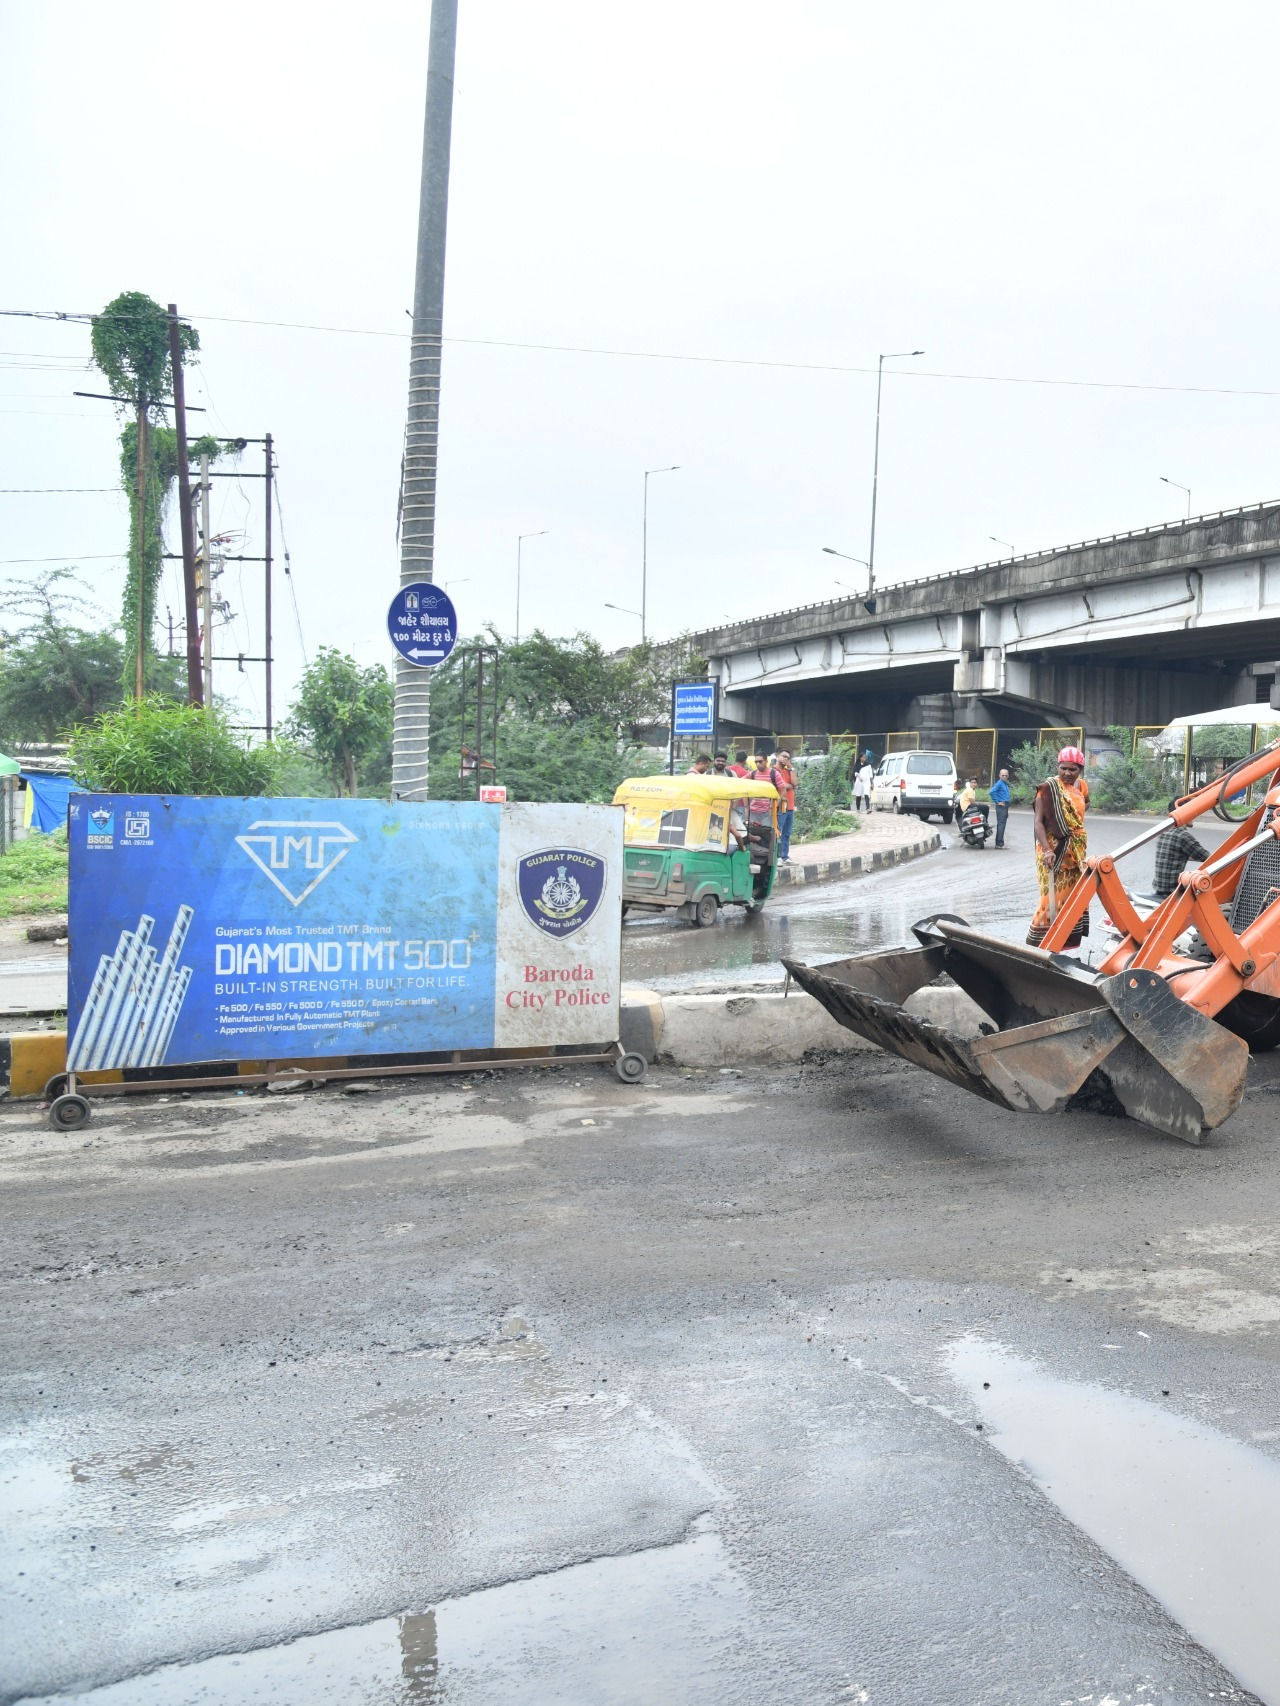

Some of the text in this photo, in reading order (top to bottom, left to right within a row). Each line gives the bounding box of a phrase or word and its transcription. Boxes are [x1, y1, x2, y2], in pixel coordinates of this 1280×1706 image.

[88, 835, 113, 844] BSCIC
[526, 854, 597, 868] GUJARAT POLICE
[215, 925, 392, 938] Gujarat's Most Trusted TMT Brand
[215, 941, 343, 976] DIAMOND
[346, 940, 400, 971] TMT
[524, 963, 595, 984] Baroda
[215, 981, 276, 995] BUILT-IN
[279, 979, 363, 993] STRENGTH.
[366, 977, 406, 990] BUILT
[407, 976, 435, 988] FOR
[220, 1004, 230, 1013] Fe
[230, 1003, 248, 1012] 500
[254, 1003, 265, 1011] Fe
[265, 1002, 282, 1011] 550
[371, 999, 394, 1008] Epoxy
[505, 987, 611, 1013] City Police
[220, 1013, 275, 1024] Manufactured
[285, 1012, 303, 1023] Fully
[304, 1010, 343, 1021] Automatic
[343, 1009, 360, 1018] TMT
[361, 1009, 381, 1018] Plant
[219, 1019, 375, 1036] Approved in Various Government Projects
